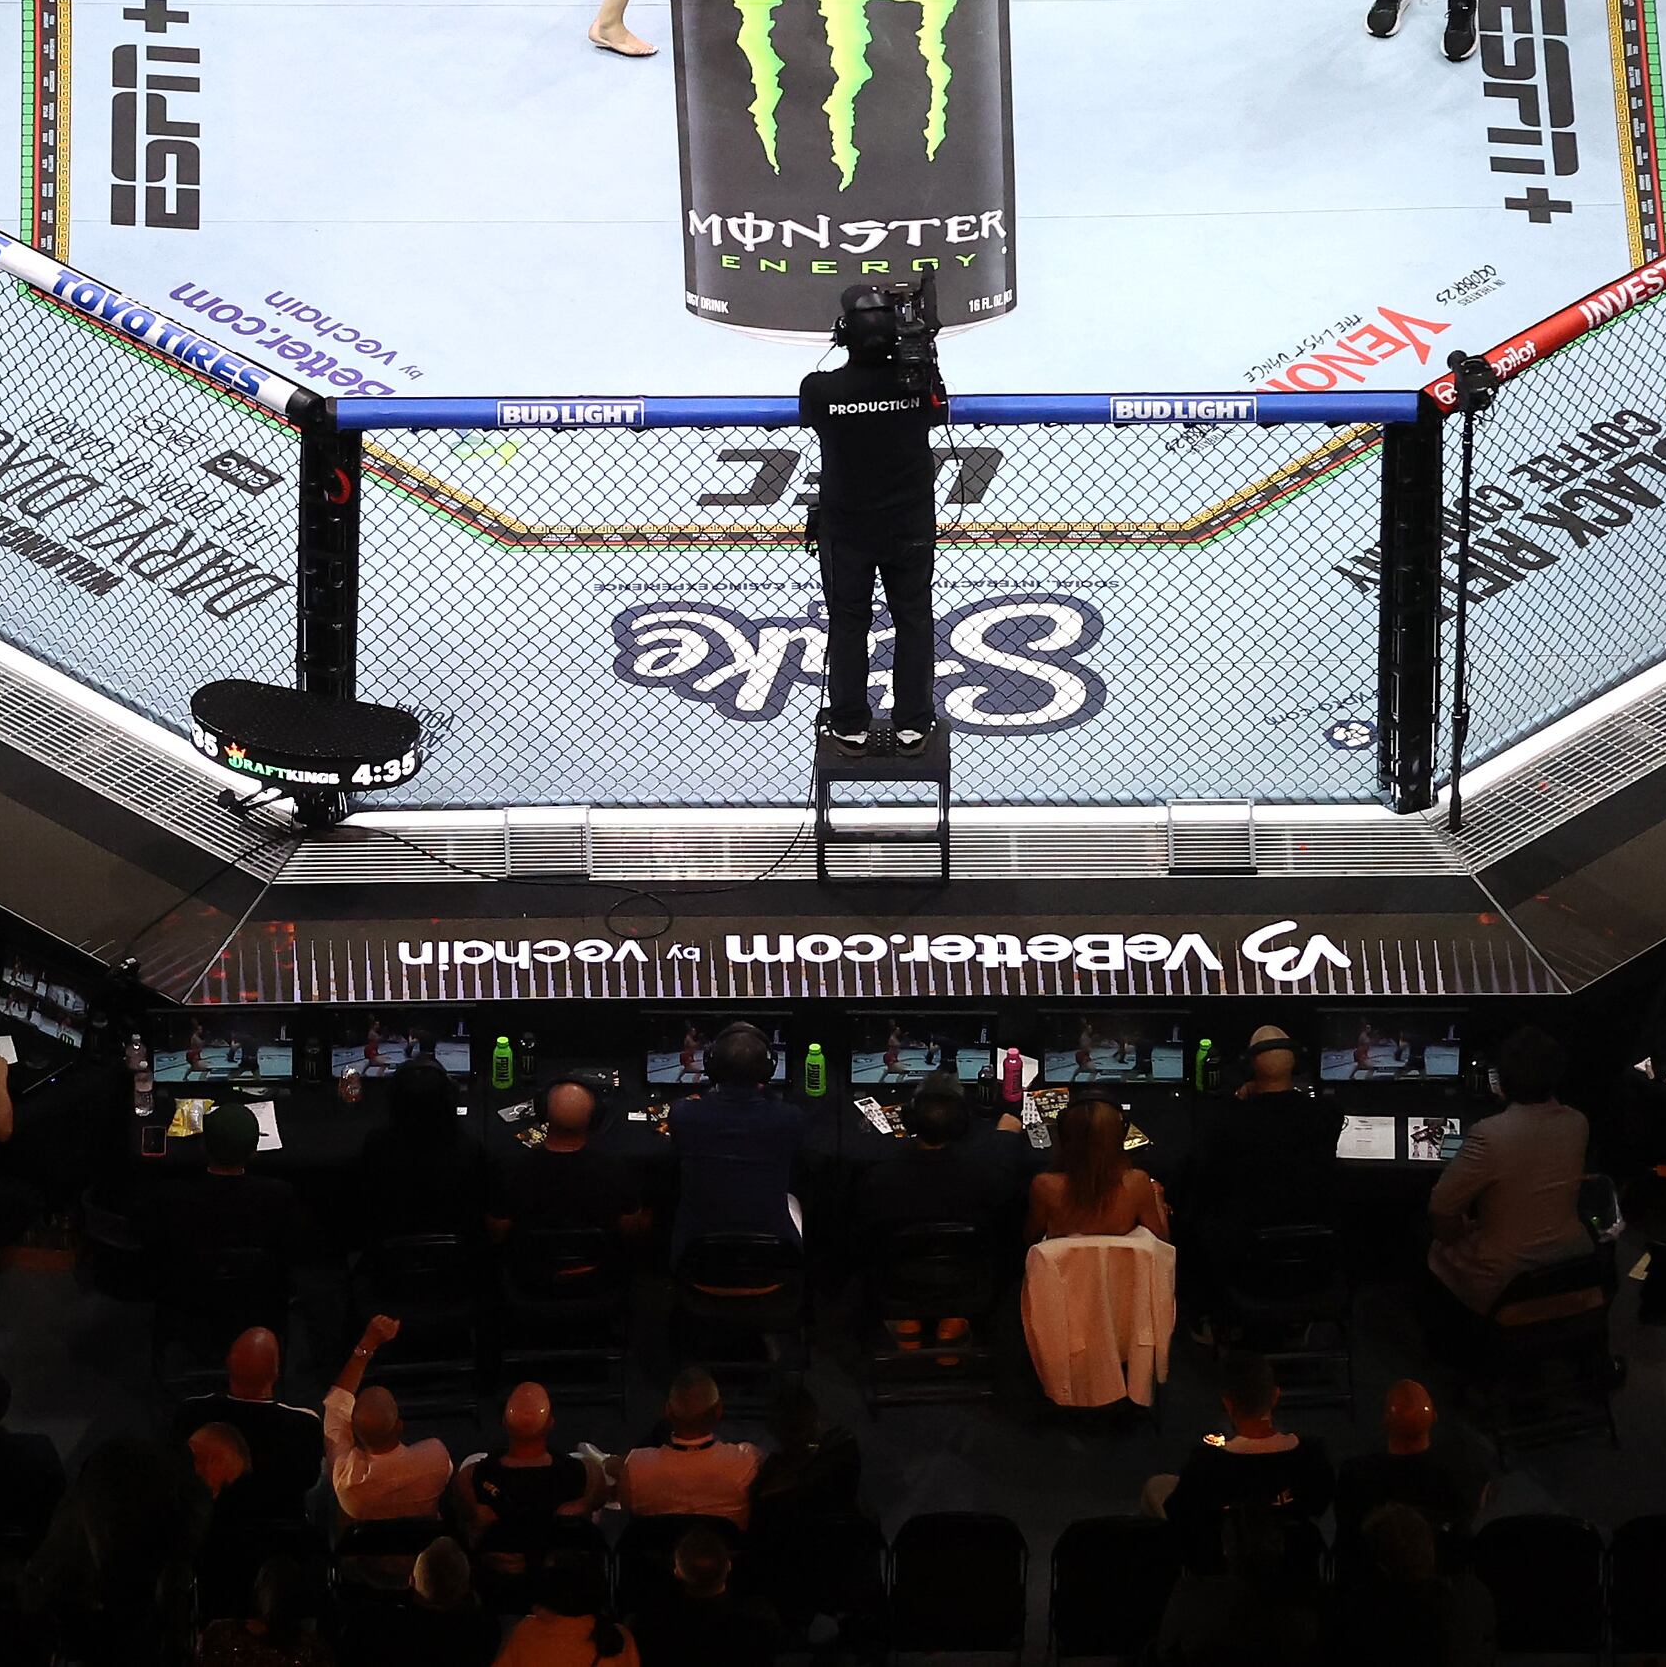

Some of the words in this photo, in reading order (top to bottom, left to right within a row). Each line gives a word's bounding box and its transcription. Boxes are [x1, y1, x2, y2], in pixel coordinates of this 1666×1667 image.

[688, 209, 1008, 254] MONSTER
[1451, 264, 1497, 295] OCTOBER
[700, 295, 730, 314] DRINK
[968, 298, 981, 313] 16
[1435, 288, 1453, 306] 25
[52, 268, 157, 342] TOYO
[153, 326, 271, 398] TIRES
[1334, 313, 1363, 333] THE
[1296, 328, 1332, 359] LAST
[398, 365, 424, 381] by
[1243, 350, 1295, 384] DANCE
[502, 403, 559, 425] BUD
[560, 403, 641, 425] LIGHT
[829, 397, 921, 415] PRODUCTION
[1115, 399, 1166, 421] BUD
[1167, 399, 1251, 421] LIGHT
[1505, 409, 1663, 492] COFFEE
[931, 579, 1039, 589] INTERACTIV
[352, 750, 416, 786] 4:35
[665, 942, 702, 964] by
[724, 933, 1223, 972] VeBetter.com
